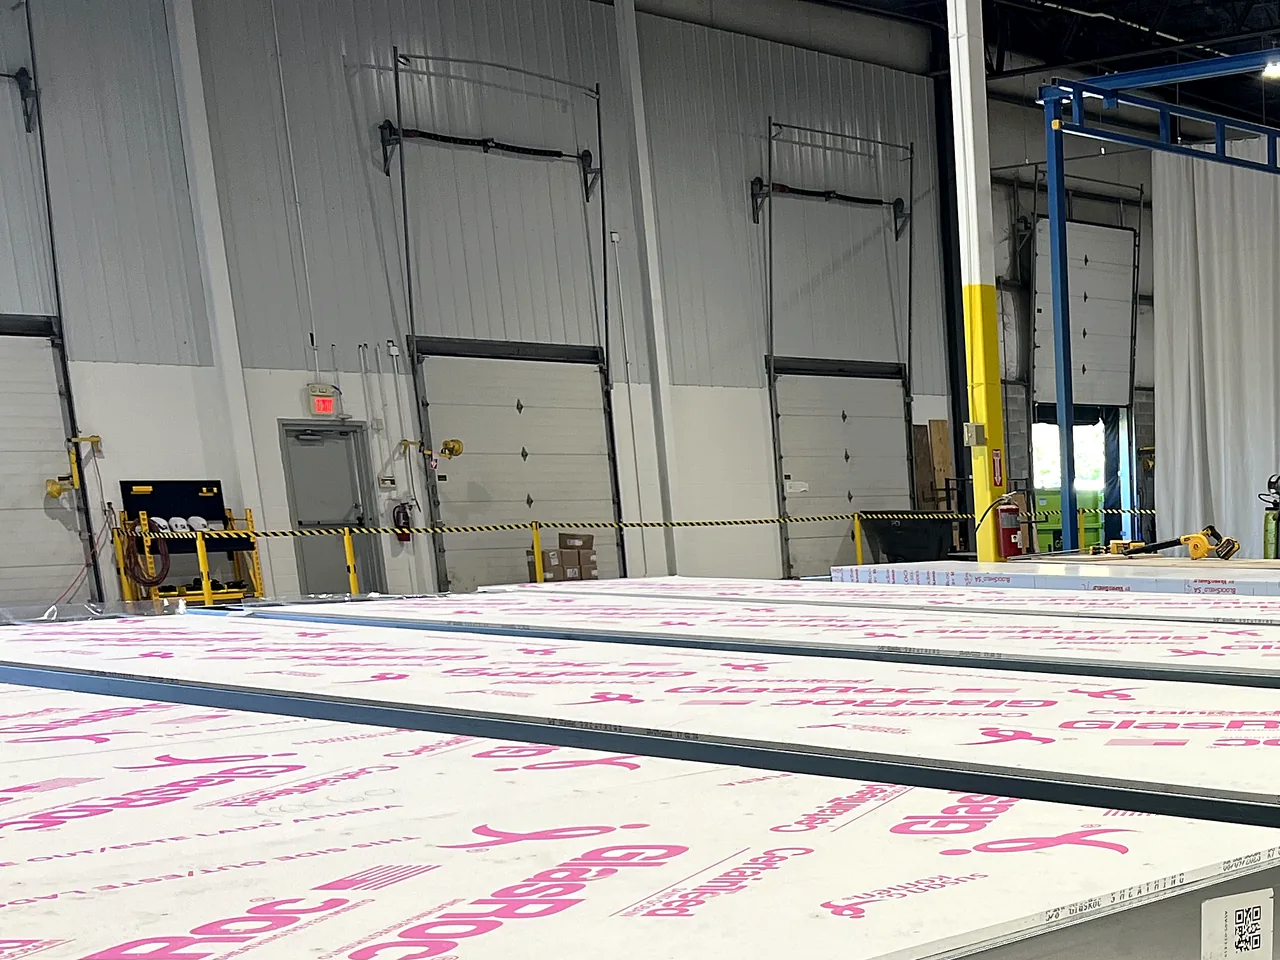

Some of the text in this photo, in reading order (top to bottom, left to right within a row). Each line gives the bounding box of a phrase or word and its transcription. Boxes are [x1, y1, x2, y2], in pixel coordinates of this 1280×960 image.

[770, 699, 1058, 708] GlasRoc
[889, 791, 1021, 834] Glas
[351, 836, 422, 848] THIS
[273, 848, 348, 862] SIDE
[641, 846, 815, 917] CertainTeed
[0, 889, 87, 909] LAD
[347, 845, 690, 960] GlasRoc
